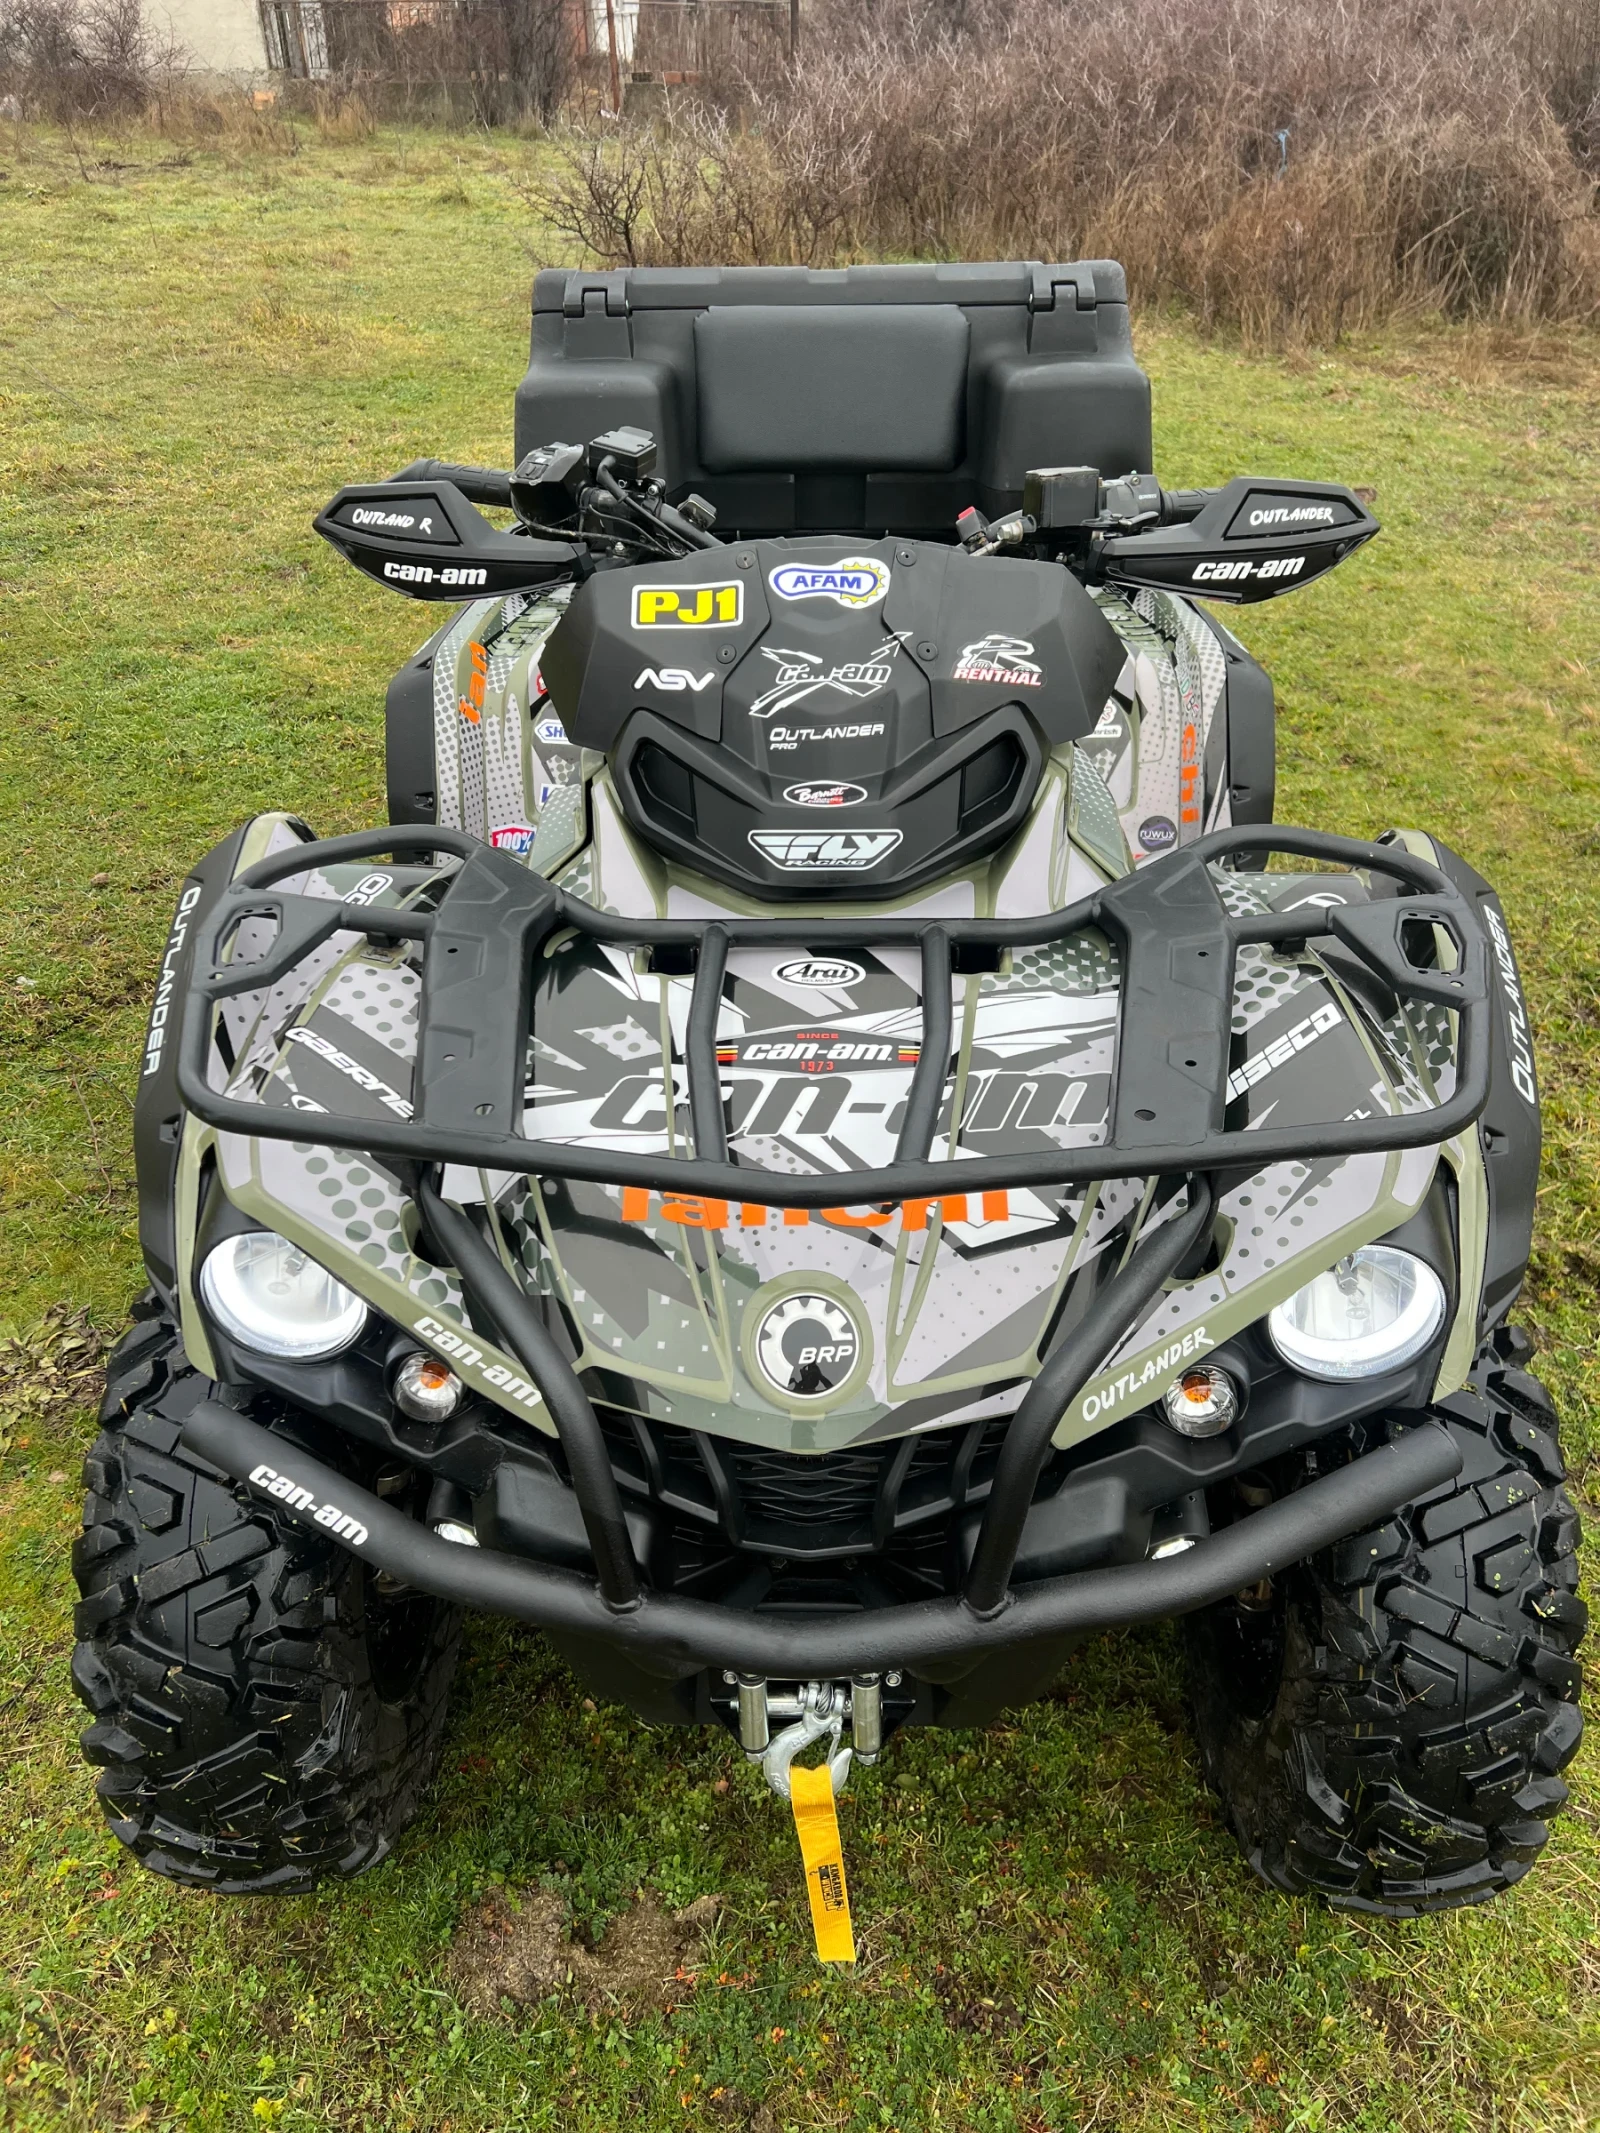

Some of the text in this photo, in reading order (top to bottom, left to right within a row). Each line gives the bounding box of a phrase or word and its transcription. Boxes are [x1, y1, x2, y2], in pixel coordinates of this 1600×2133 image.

[352, 508, 433, 534] OUTLAND R
[1250, 507, 1334, 525] OUTLANDER
[384, 562, 487, 585] can-am
[1192, 556, 1305, 580] can-am
[792, 575, 862, 590] AFAM
[639, 587, 737, 623] PJ1
[634, 668, 715, 691] ASV
[953, 668, 1042, 686] RENTHAL
[545, 726, 567, 738] SH
[769, 723, 885, 742] OUTLANDER
[769, 742, 798, 750] PRO
[494, 831, 532, 851] 100%
[752, 835, 898, 860] FLY
[784, 858, 867, 866] RACING
[143, 886, 201, 1076] OUTLANDER
[782, 963, 850, 979] Arai
[1483, 904, 1535, 1105] OUTLANDER
[742, 1043, 892, 1061] can-am
[1226, 1002, 1343, 1106] ISECO
[800, 1060, 835, 1072] 1973
[412, 1316, 543, 1408] can-am
[798, 1344, 854, 1366] BRP
[1082, 1326, 1215, 1423] OUTLANDER
[248, 1464, 369, 1546] can-am
